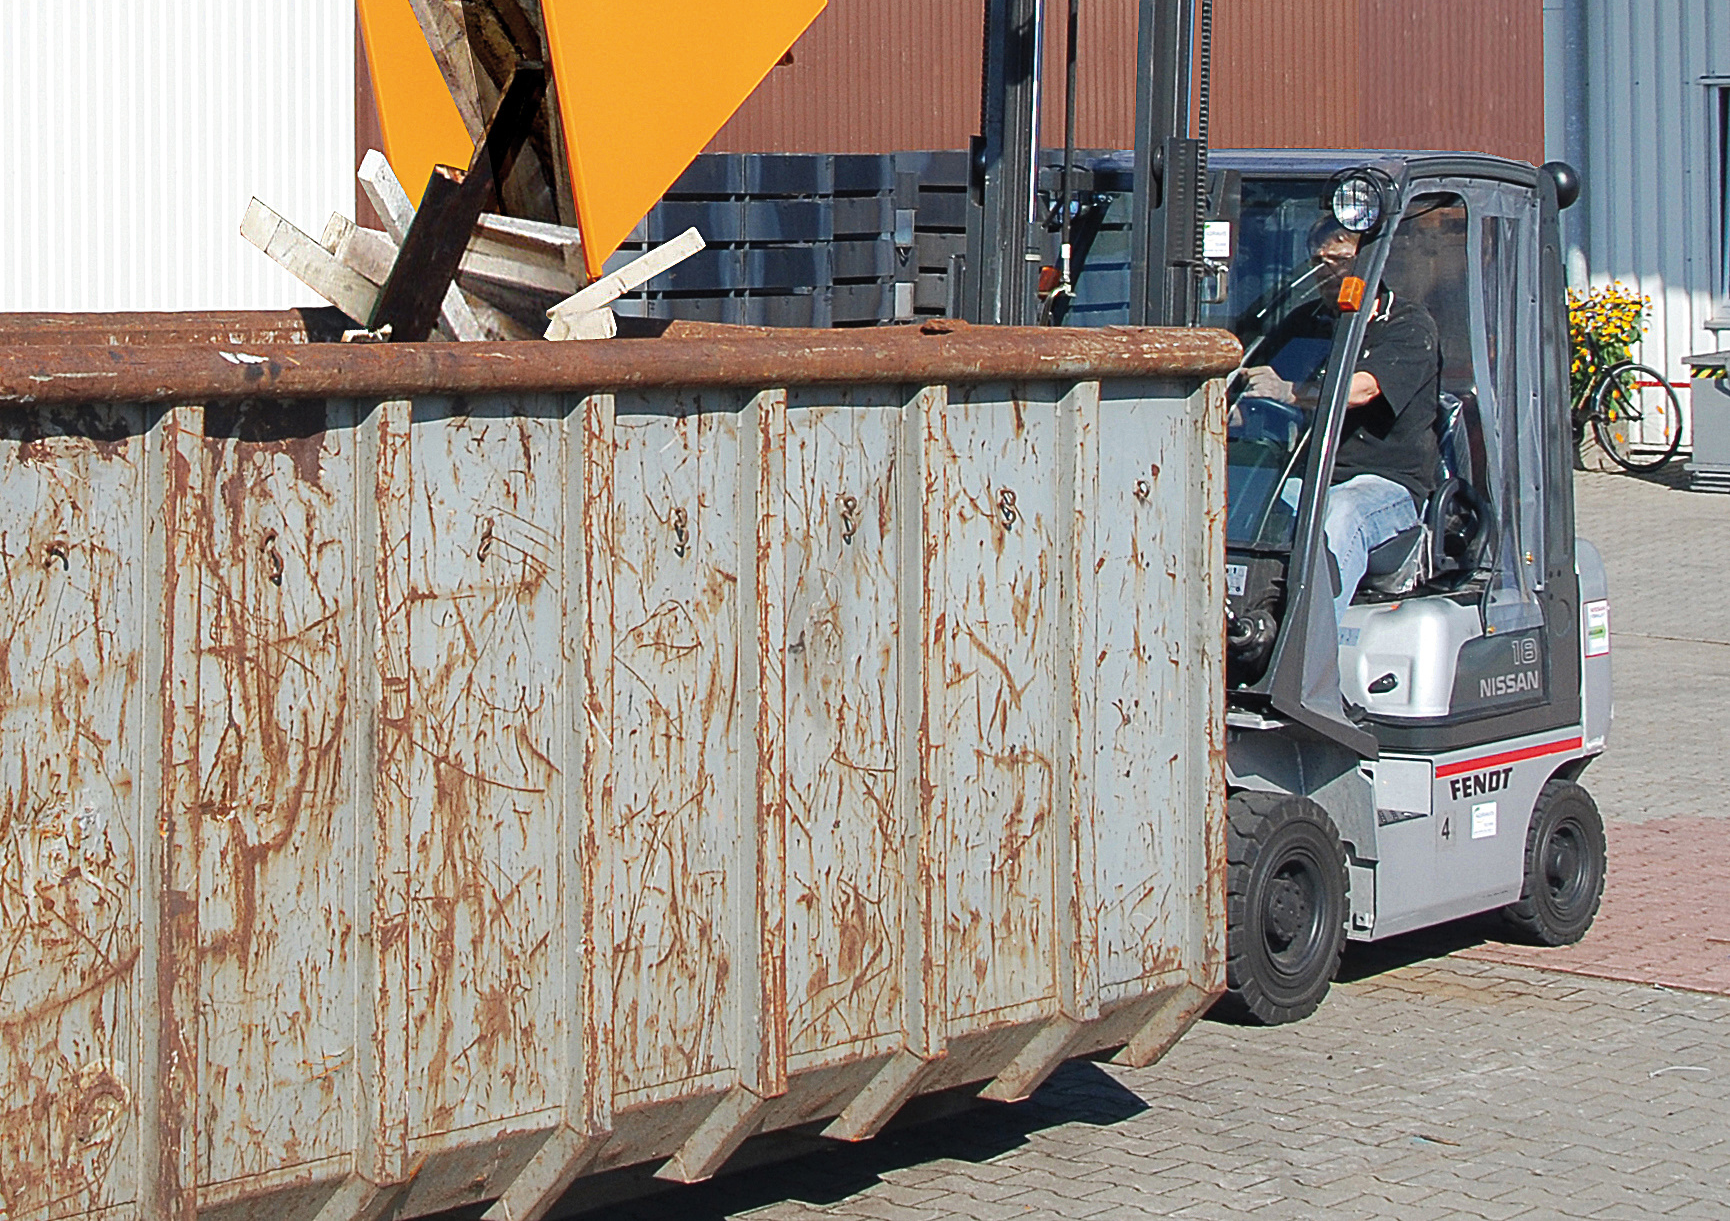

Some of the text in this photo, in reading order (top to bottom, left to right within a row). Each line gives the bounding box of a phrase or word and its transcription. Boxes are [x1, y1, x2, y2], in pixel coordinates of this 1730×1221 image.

[1511, 638, 1538, 665] 18
[1480, 670, 1538, 698] NISSAN
[1450, 767, 1513, 800] FENDT
[1441, 816, 1451, 840] 4
